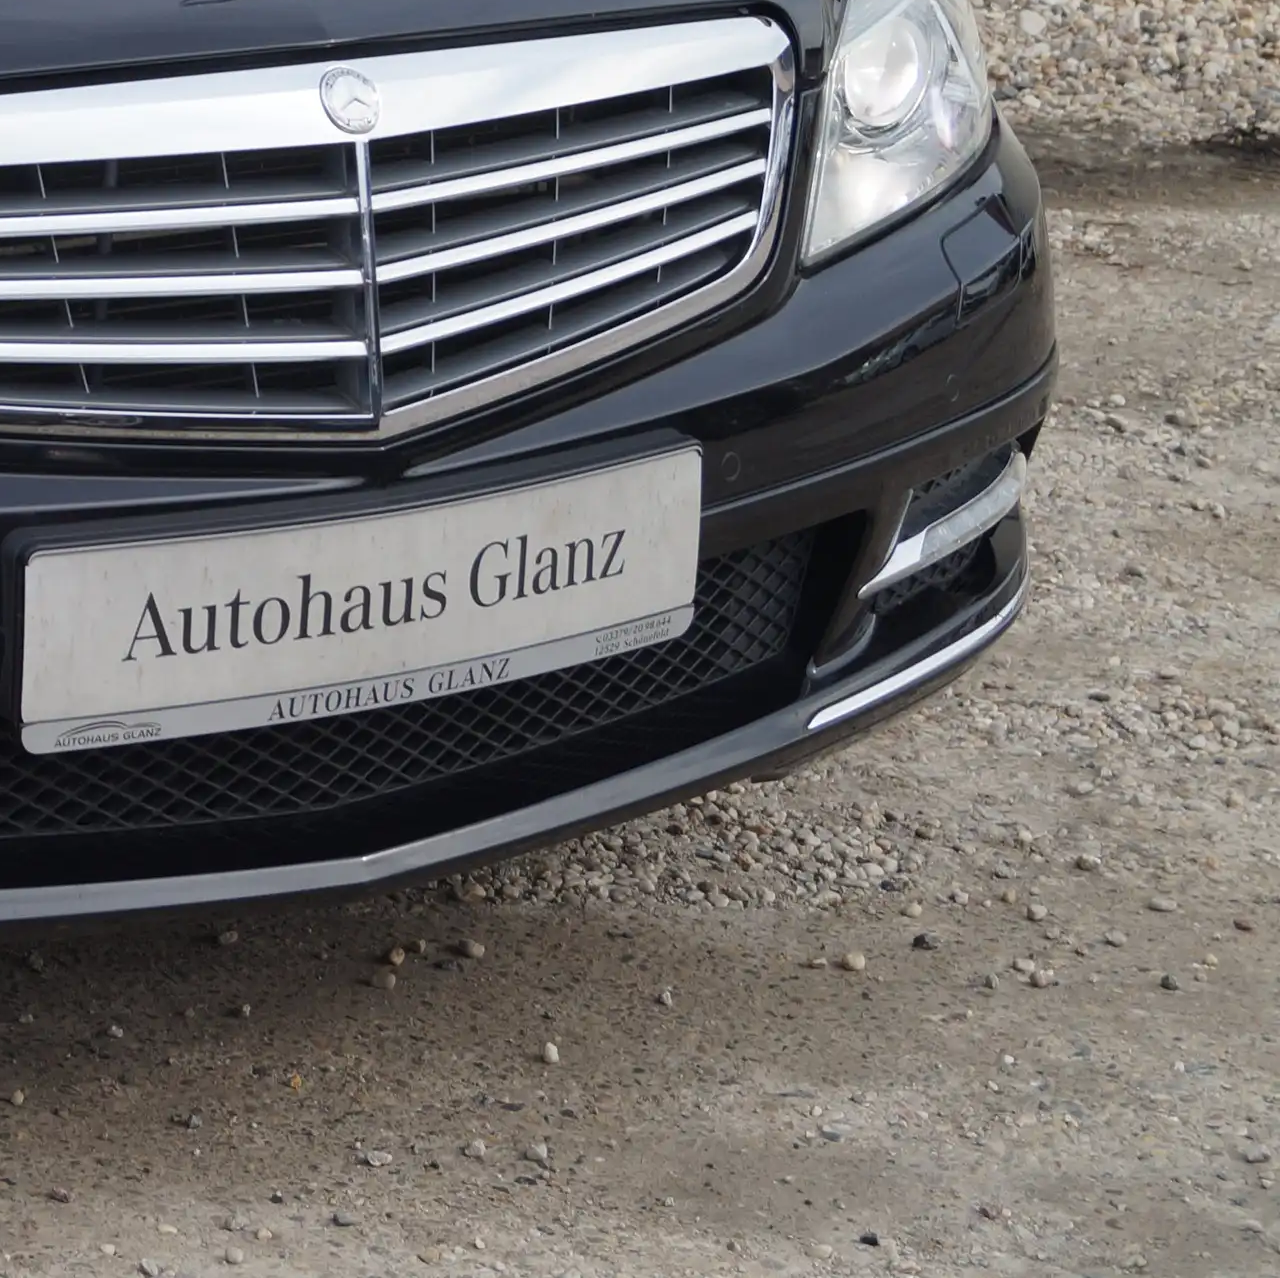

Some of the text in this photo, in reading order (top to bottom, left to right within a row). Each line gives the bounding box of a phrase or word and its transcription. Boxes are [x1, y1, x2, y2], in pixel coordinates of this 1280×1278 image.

[122, 528, 627, 663] Autohaus Glanz
[268, 657, 511, 723] AUTOHAUS GLANZ
[53, 727, 162, 748] AUTOHAUS GLANZ
